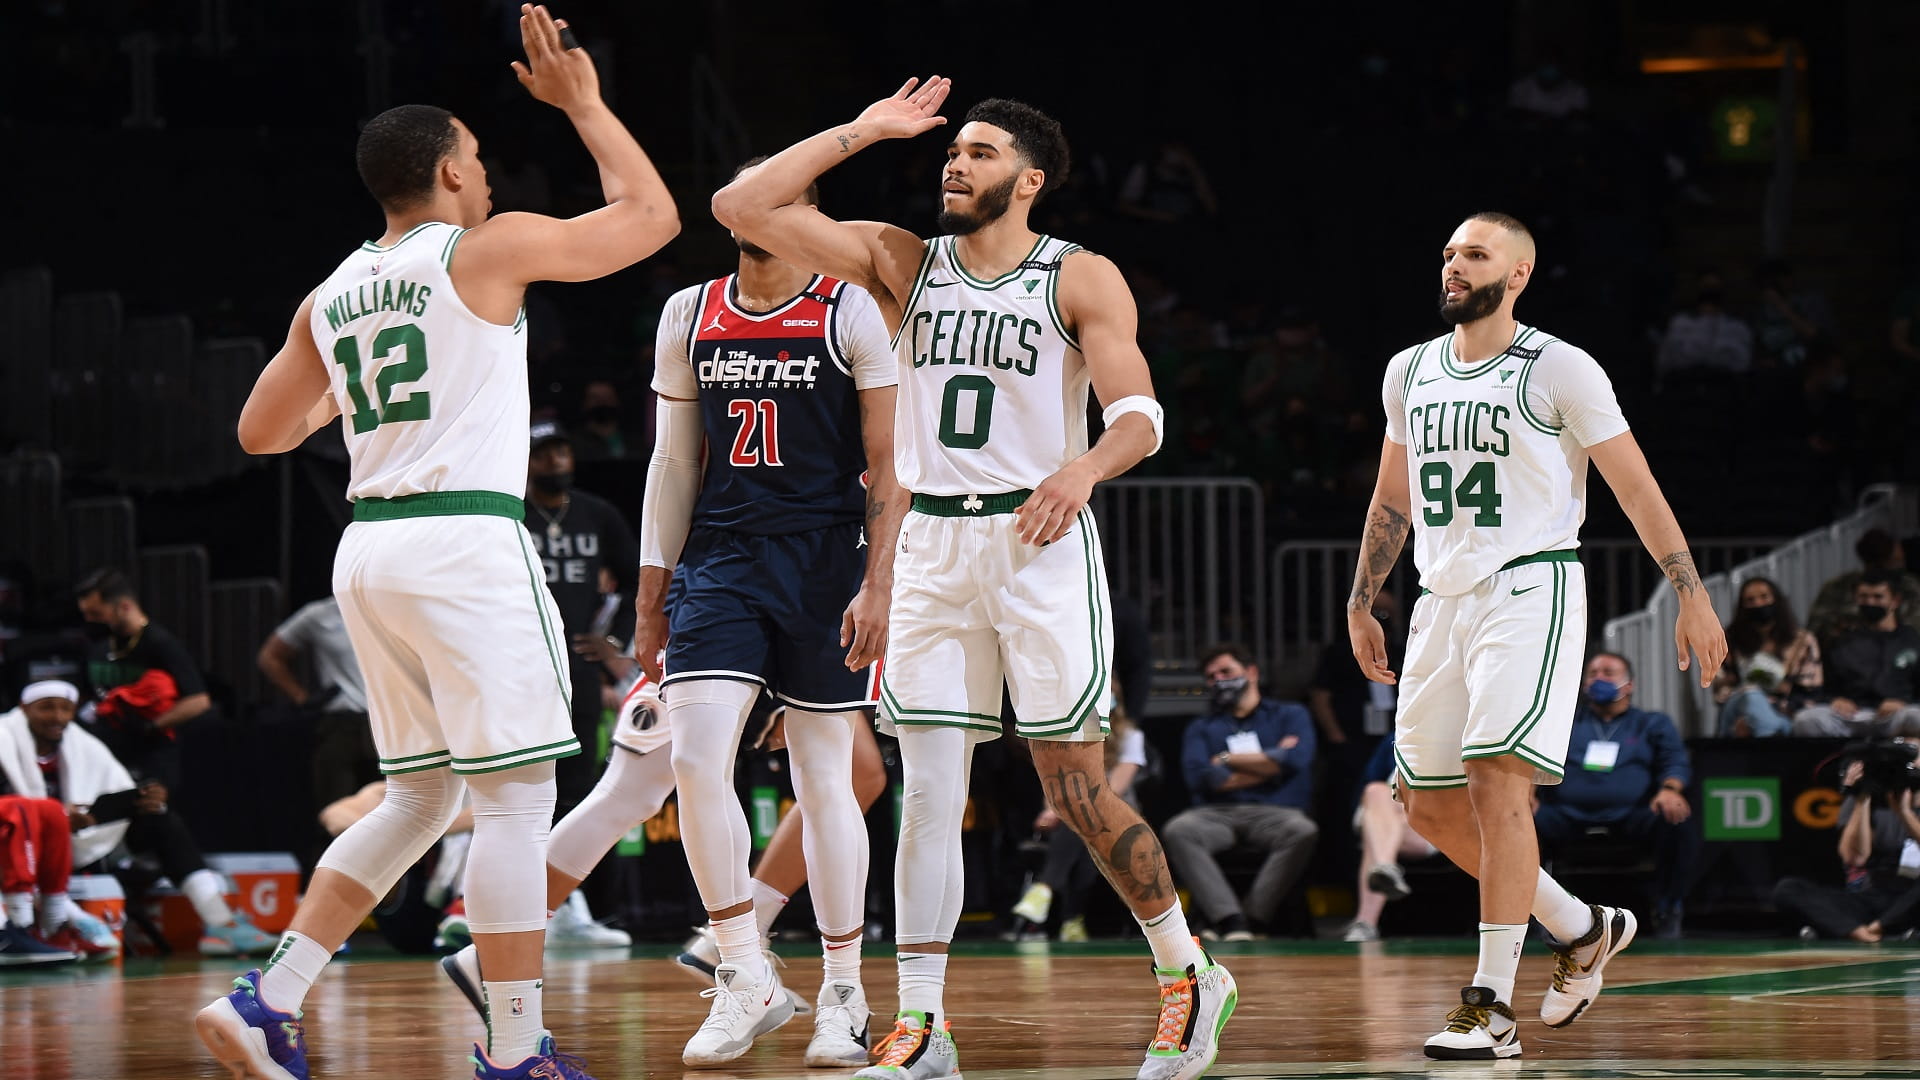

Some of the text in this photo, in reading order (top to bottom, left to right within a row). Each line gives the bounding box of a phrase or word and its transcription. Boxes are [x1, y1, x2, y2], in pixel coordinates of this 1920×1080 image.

[324, 279, 432, 332] WILLIAMS
[782, 319, 819, 327] GEICO
[698, 347, 820, 382] district
[728, 351, 748, 360] THE
[912, 310, 1042, 377] CELTICS
[333, 323, 431, 435] 12
[722, 381, 816, 391] COLUMBIA
[728, 398, 785, 467] 21
[938, 374, 996, 450] 0
[1410, 401, 1510, 458] CELTICS
[1420, 461, 1502, 528] 94
[1710, 788, 1773, 829] TD
[251, 878, 279, 917] G
